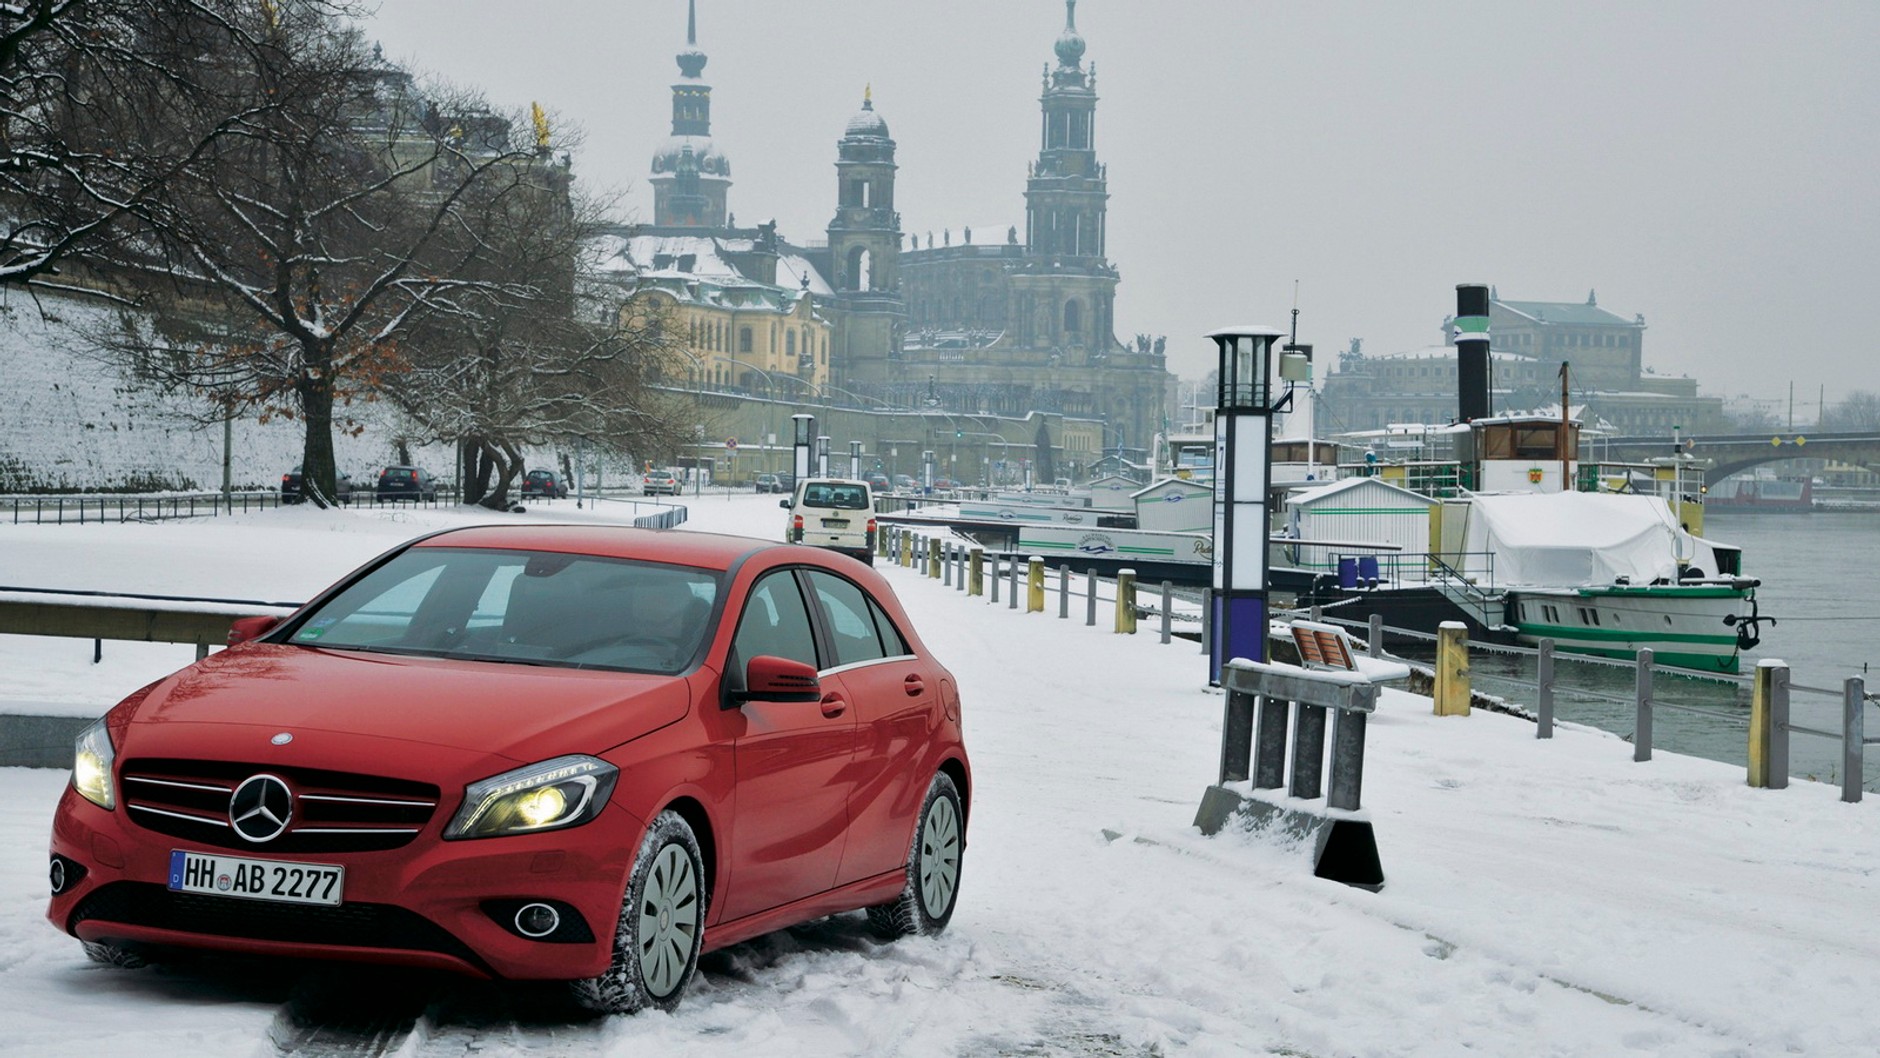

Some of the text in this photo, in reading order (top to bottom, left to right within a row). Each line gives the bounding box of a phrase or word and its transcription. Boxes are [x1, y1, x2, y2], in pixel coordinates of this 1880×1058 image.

[184, 857, 339, 900] HH AB 2277
